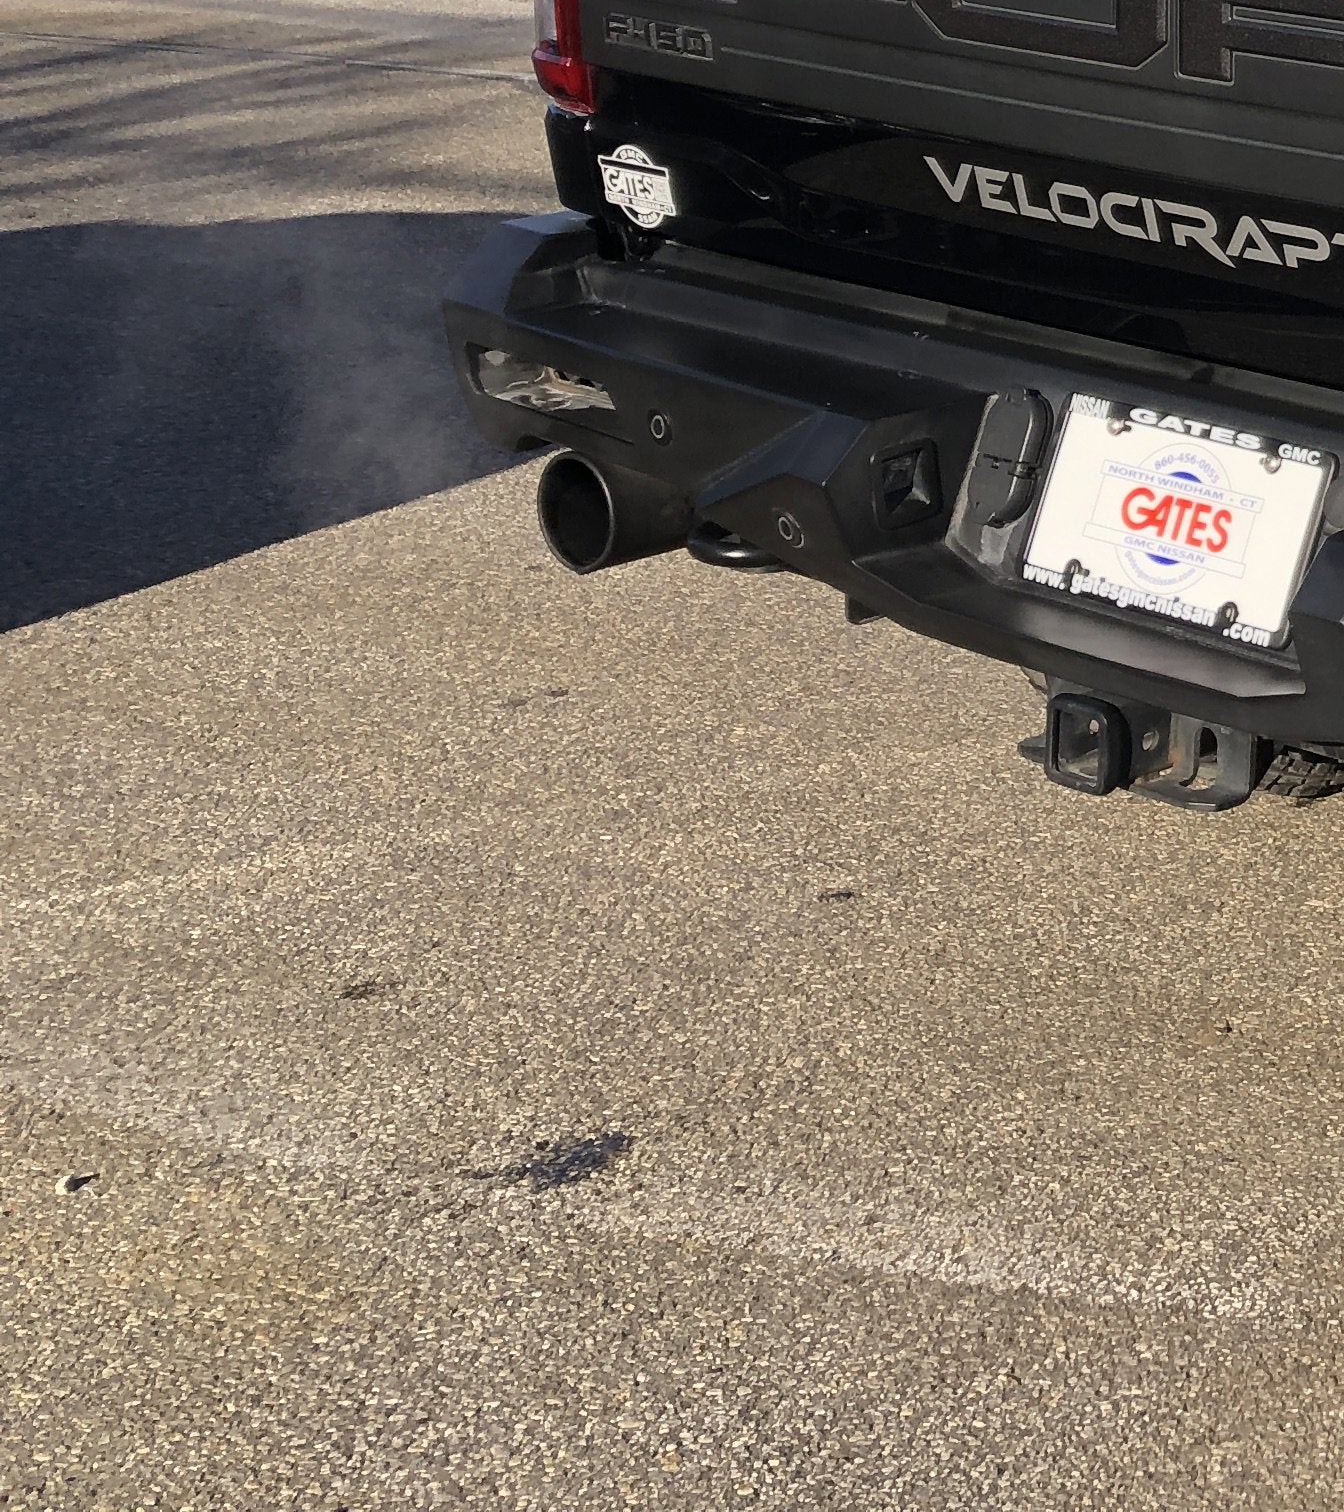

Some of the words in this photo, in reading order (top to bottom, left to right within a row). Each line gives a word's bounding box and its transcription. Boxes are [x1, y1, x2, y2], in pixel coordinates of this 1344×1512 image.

[605, 168, 655, 201] GATES
[1069, 392, 1111, 420] NISSAN
[1129, 407, 1262, 450] GATES
[1278, 443, 1322, 466] GMC
[1108, 464, 1154, 483] NORTH
[1157, 475, 1225, 501] WINDHAM
[1239, 498, 1259, 509] CT
[1154, 452, 1220, 484] 860-456-0055
[1121, 487, 1233, 554] GATES
[1124, 535, 1155, 551] GMC
[1156, 544, 1206, 563] NISSAN
